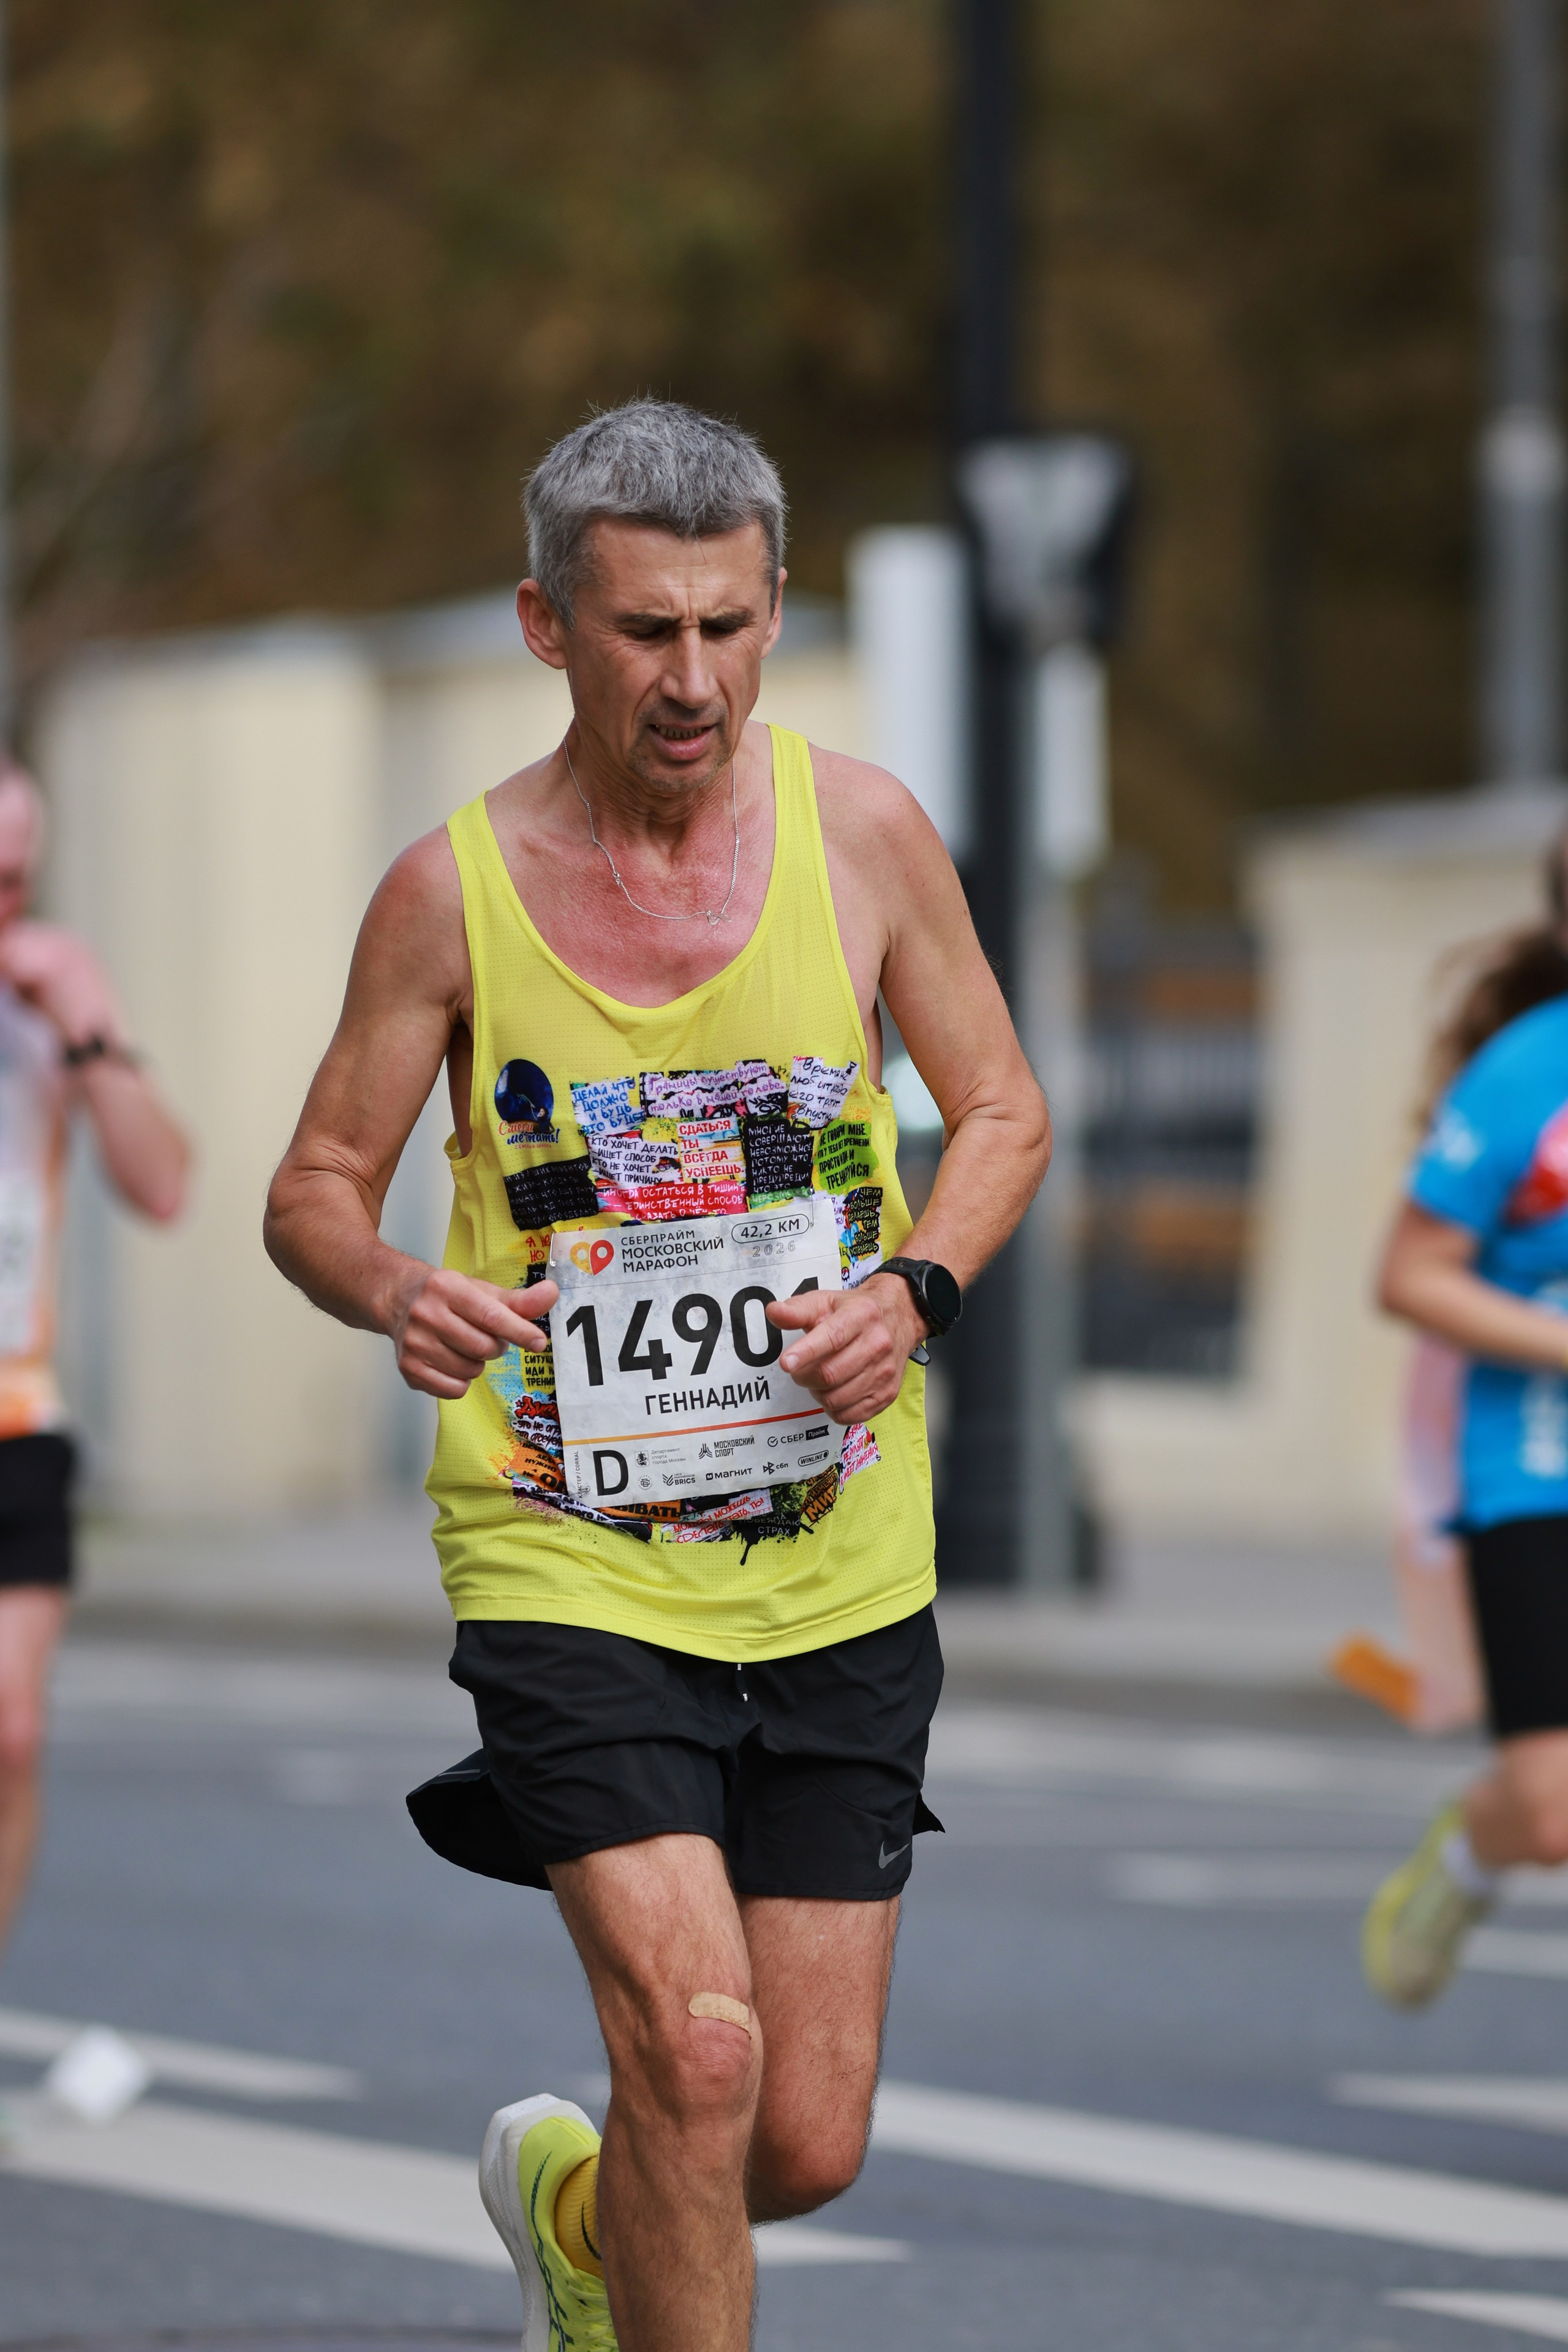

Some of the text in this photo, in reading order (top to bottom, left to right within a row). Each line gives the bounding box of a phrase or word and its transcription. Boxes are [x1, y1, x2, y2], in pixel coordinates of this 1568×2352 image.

[649, 1065, 767, 1095] Границы существуют
[571, 1079, 636, 1102] ДЕЛАЙ ЧТО
[696, 1095, 703, 1106] в
[706, 1090, 738, 1103] нашей
[789, 1091, 814, 1102] его
[582, 1092, 628, 1113] ДОЛЖНО
[589, 1102, 632, 1121] И БУДЬ
[499, 1120, 533, 1136] Смеем
[581, 1122, 605, 1134] ЧТО
[679, 1120, 731, 1136] СДАТЬСЯ
[748, 1124, 785, 1136] МНОГИЕ
[507, 1128, 560, 1145] мечтать!
[680, 1139, 699, 1149] ТЫ
[749, 1134, 810, 1147] СОВЕРШАЮТ
[592, 1137, 678, 1155] КТО ХОЧЕТ ДЕЛАТЬ
[592, 1156, 607, 1167] КТО
[623, 1163, 651, 1173] ХОЧЕТ
[625, 1153, 656, 1163] СПОСОБ
[684, 1150, 729, 1164] ВСЕГДА
[752, 1153, 809, 1167] ПОТОМУ ЧТО
[625, 1174, 662, 1186] ПРИЧИНУ
[753, 1172, 809, 1186] ПРЕДУПРЕДИЛ
[603, 1188, 639, 1199] ИНОГДА
[642, 1185, 695, 1198] ОСТАТЬСЯ
[697, 1184, 704, 1194] В
[850, 1199, 880, 1210] БОЛЬШЕ
[741, 1218, 800, 1238] 42,2 КМ
[862, 1220, 878, 1229] ТЕМ
[526, 1236, 536, 1248] Я
[620, 1229, 695, 1246] СБЕРПРАЙМ
[854, 1231, 878, 1243] БОЛЬШЕ
[622, 1236, 724, 1260] МОСКОВСКИЙ
[624, 1255, 698, 1273] МАРАФОН
[526, 1366, 544, 1376] ИДИ
[644, 1376, 771, 1415] ГЕННАДИЙ
[714, 1435, 755, 1450] МОСКОВСКИЙ
[780, 1428, 826, 1444] СБЕР Прайм
[715, 1448, 734, 1458] СПОРТ
[800, 1453, 824, 1466] WINLINE
[592, 1449, 630, 1497] D
[714, 1496, 751, 1519] МОЖЕШЬ
[758, 1526, 790, 1536] СТРАХ
